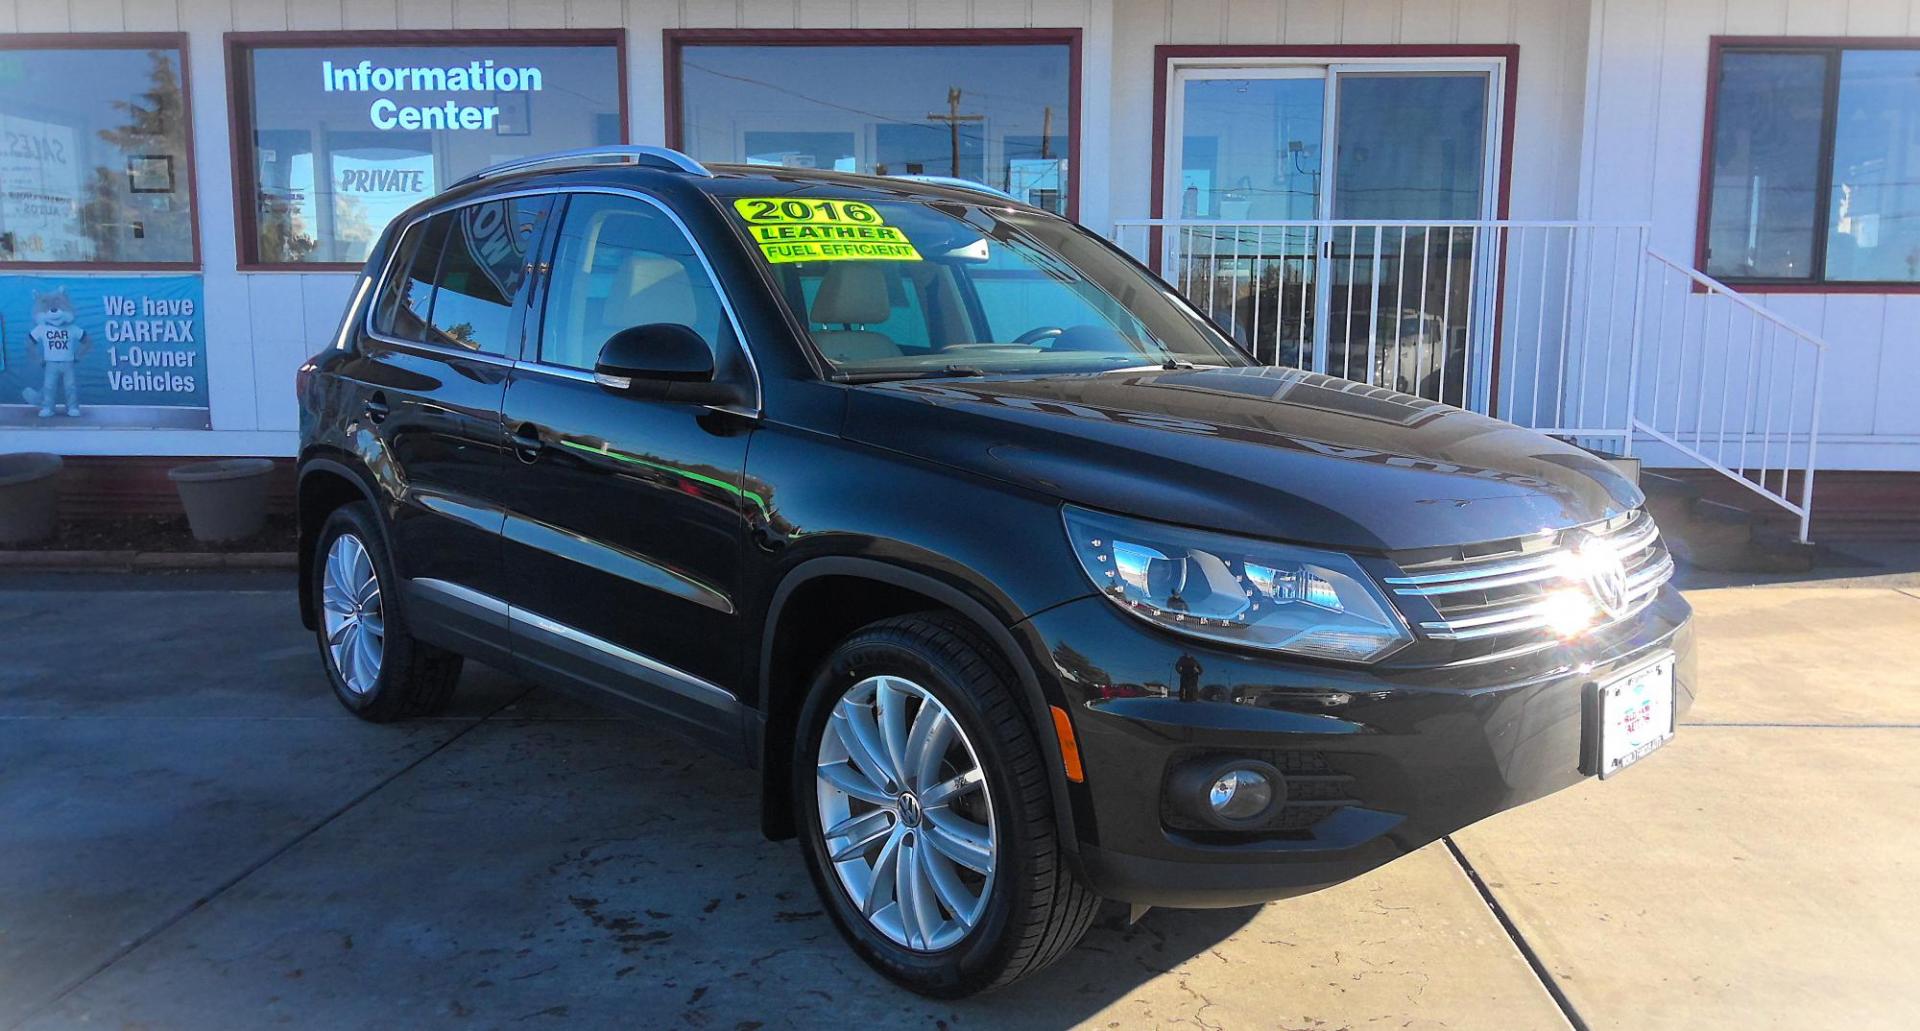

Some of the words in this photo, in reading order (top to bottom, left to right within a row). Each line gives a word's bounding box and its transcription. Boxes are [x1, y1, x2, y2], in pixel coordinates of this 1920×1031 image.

[322, 60, 543, 92] Information
[370, 98, 499, 130] Center
[341, 169, 424, 193] PRIVATE
[746, 200, 877, 223] 2016
[760, 226, 896, 240] LEATHER
[766, 245, 817, 257] FUEL
[821, 243, 913, 257] EFFICIENT
[102, 295, 136, 317] We
[142, 295, 194, 317] have
[46, 330, 69, 340] CAR
[104, 320, 194, 342] CARFAX
[48, 340, 69, 350] FOX
[106, 346, 197, 367] 1-Owner
[107, 371, 196, 393] Vehicles
